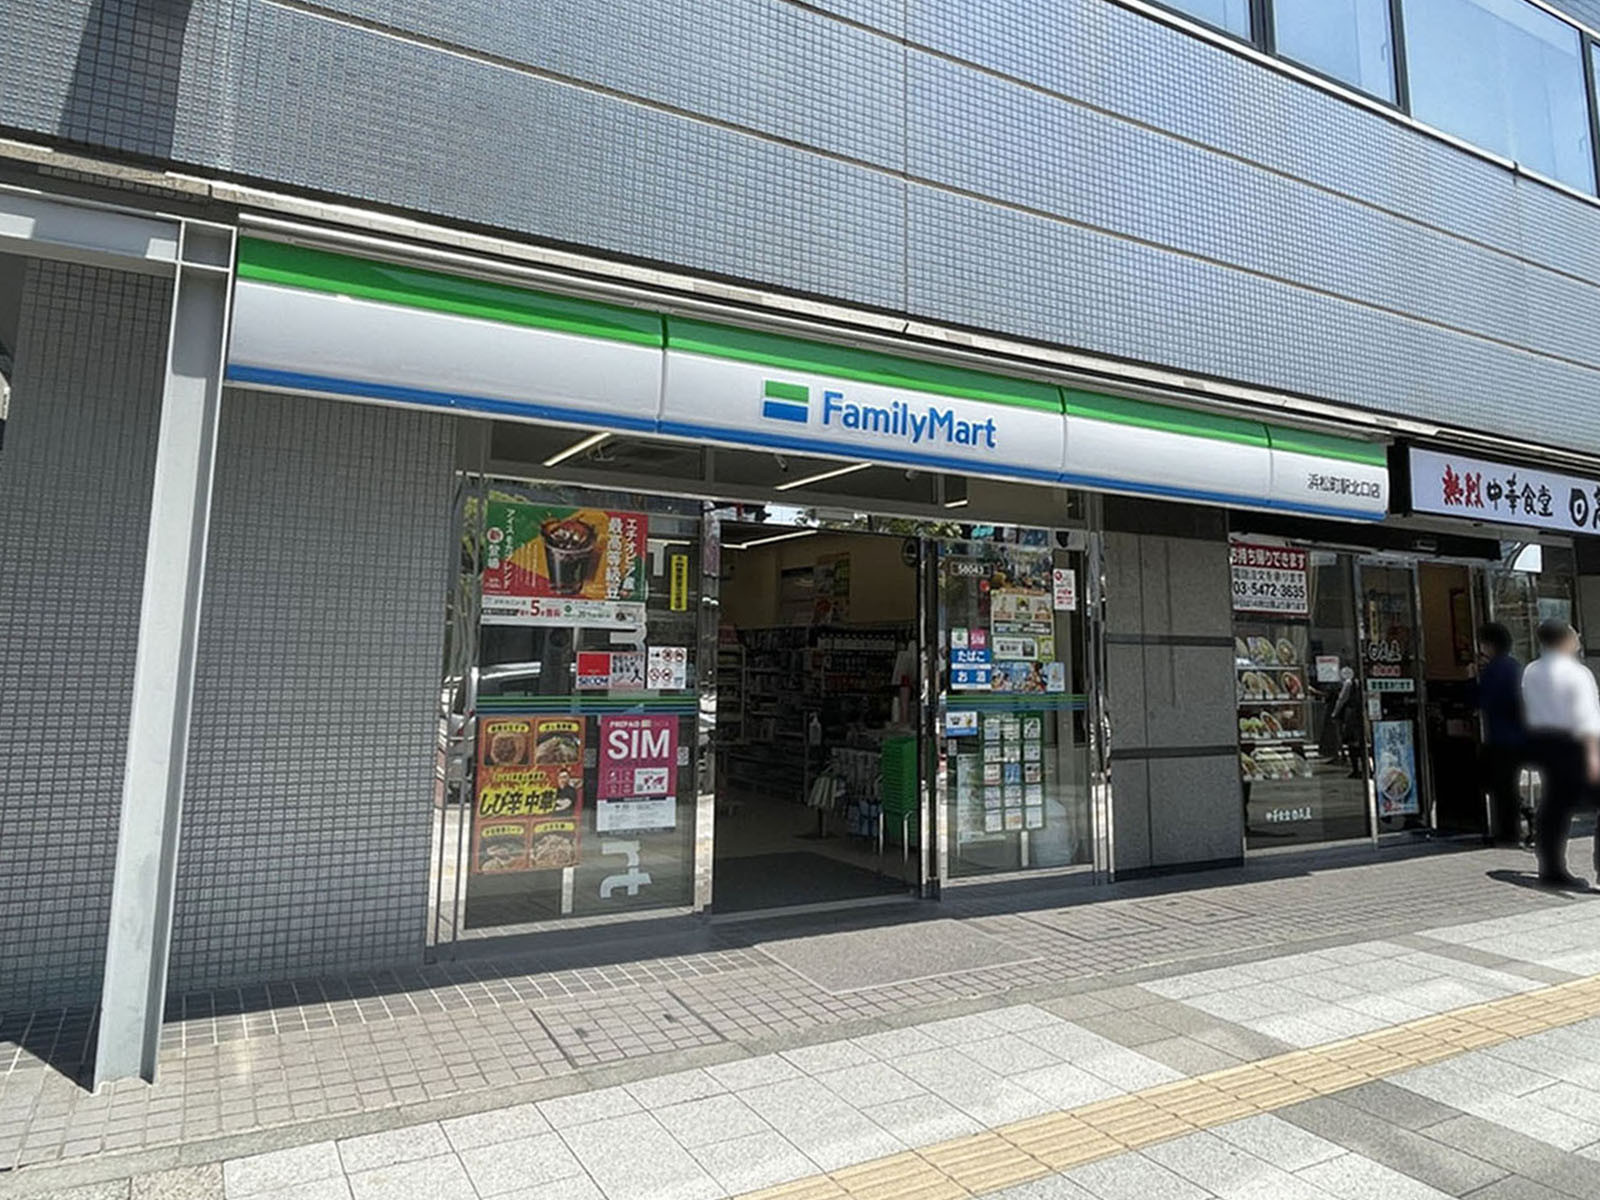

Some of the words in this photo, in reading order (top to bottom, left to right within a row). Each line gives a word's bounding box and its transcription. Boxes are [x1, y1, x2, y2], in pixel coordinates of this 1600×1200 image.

[822, 390, 997, 448] FamilyMart
[1442, 464, 1554, 517] 熱烈中華食堂
[1569, 486, 1600, 529] 日
[957, 650, 986, 662] たばこ
[607, 729, 670, 760] SIM
